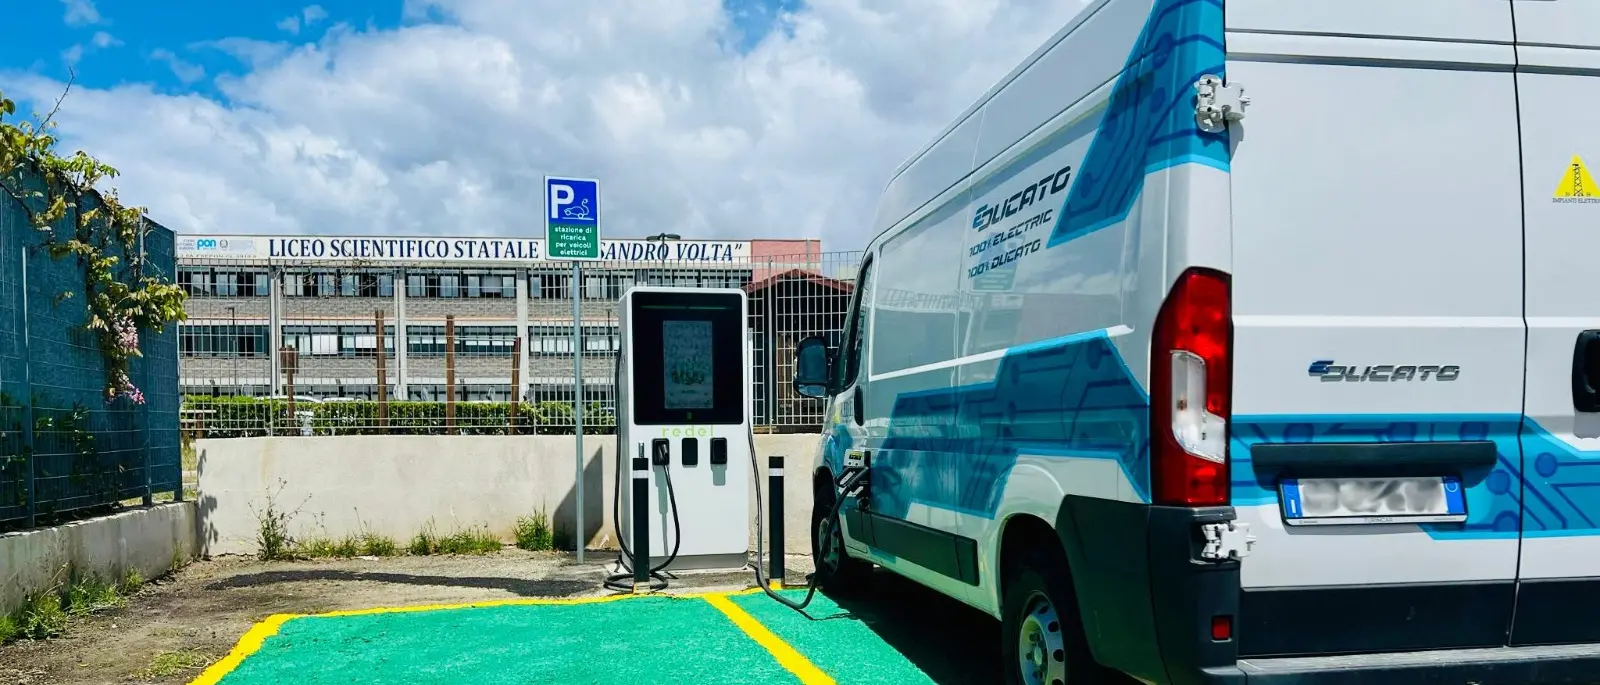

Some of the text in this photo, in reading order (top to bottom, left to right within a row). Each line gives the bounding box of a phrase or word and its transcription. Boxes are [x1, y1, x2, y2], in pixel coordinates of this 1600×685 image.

[551, 184, 574, 219] P
[992, 209, 1054, 246] ELECTRIC
[197, 239, 216, 250] pon
[269, 239, 325, 258] LICEO
[330, 239, 450, 258] SCIENTIFICO
[454, 240, 539, 259] STATALE
[990, 238, 1041, 269] DUCATO
[662, 425, 714, 437] redel
